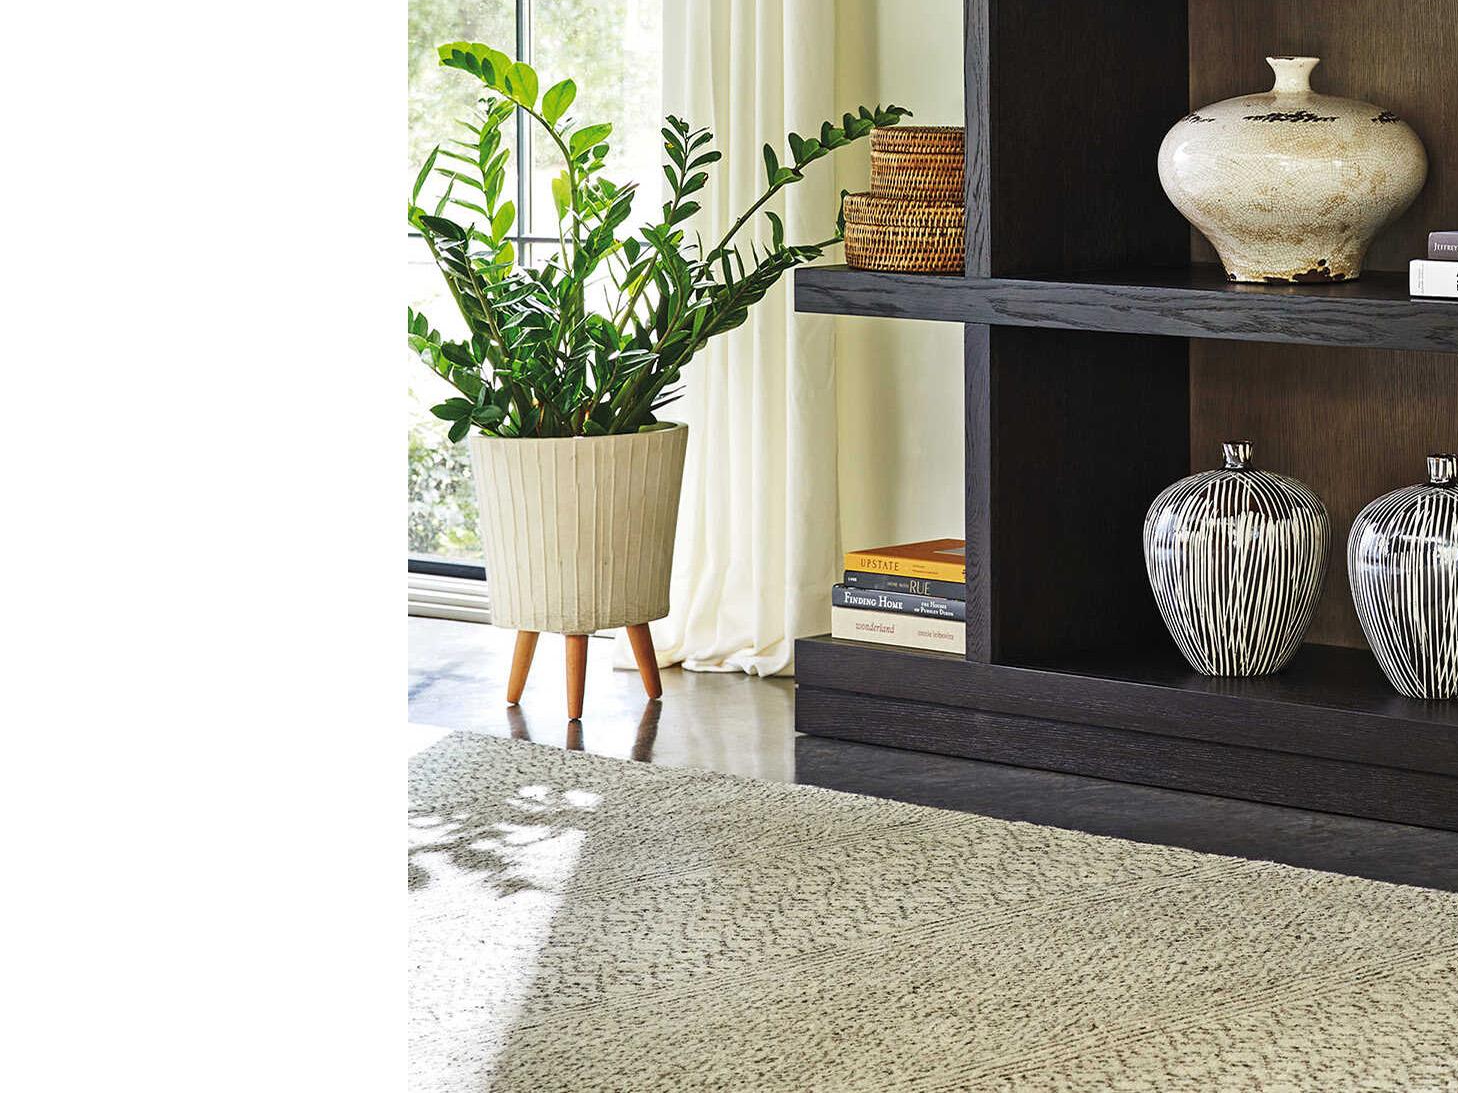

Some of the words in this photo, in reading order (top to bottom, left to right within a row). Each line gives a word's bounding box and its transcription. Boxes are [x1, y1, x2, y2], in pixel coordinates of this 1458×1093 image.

[860, 558, 900, 572] UPSTATE
[909, 579, 931, 596] RUE
[843, 591, 877, 606] FINDING
[878, 595, 904, 610] HOME
